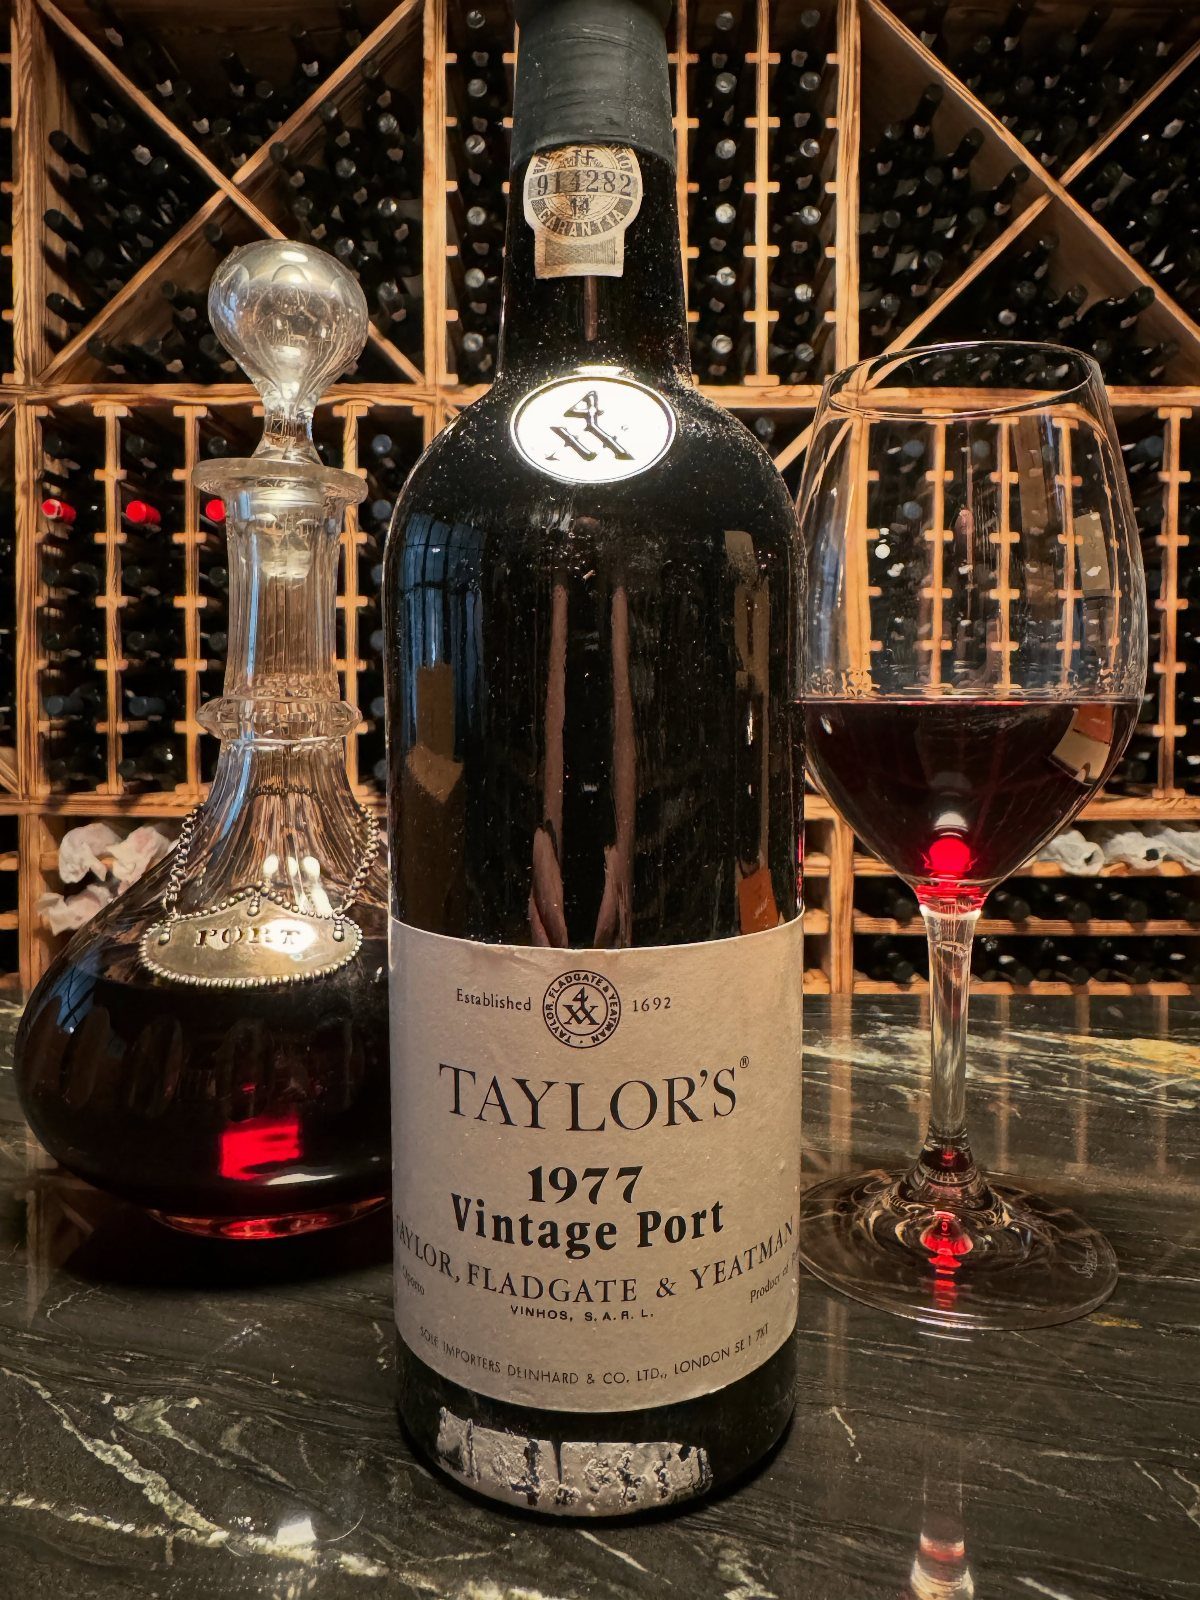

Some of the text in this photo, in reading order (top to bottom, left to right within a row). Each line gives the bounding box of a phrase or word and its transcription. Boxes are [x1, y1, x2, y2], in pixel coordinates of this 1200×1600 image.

[539, 207, 626, 237] GARANTIA
[193, 926, 302, 949] PORT
[456, 987, 532, 1012] Established
[548, 973, 604, 999] FLADGATE
[590, 992, 619, 1044] YEATMAN
[632, 996, 672, 1012] 1692
[438, 1062, 737, 1132] TAYLOR'S
[527, 1165, 644, 1205] 1977
[450, 1192, 725, 1260] Vintage Port
[395, 1213, 793, 1303] TAYLOR, FLADGATE & YEATMAN
[510, 1304, 574, 1323] VINHOS,
[419, 1325, 439, 1349] SOLE
[443, 1341, 501, 1374] IMPORTERS
[507, 1364, 579, 1385] DEINHARD
[586, 1373, 596, 1385] &
[603, 1372, 630, 1385] CO.
[673, 1346, 731, 1375] LONDON
[734, 1339, 745, 1354] SE
[755, 1322, 769, 1342] 7XT
